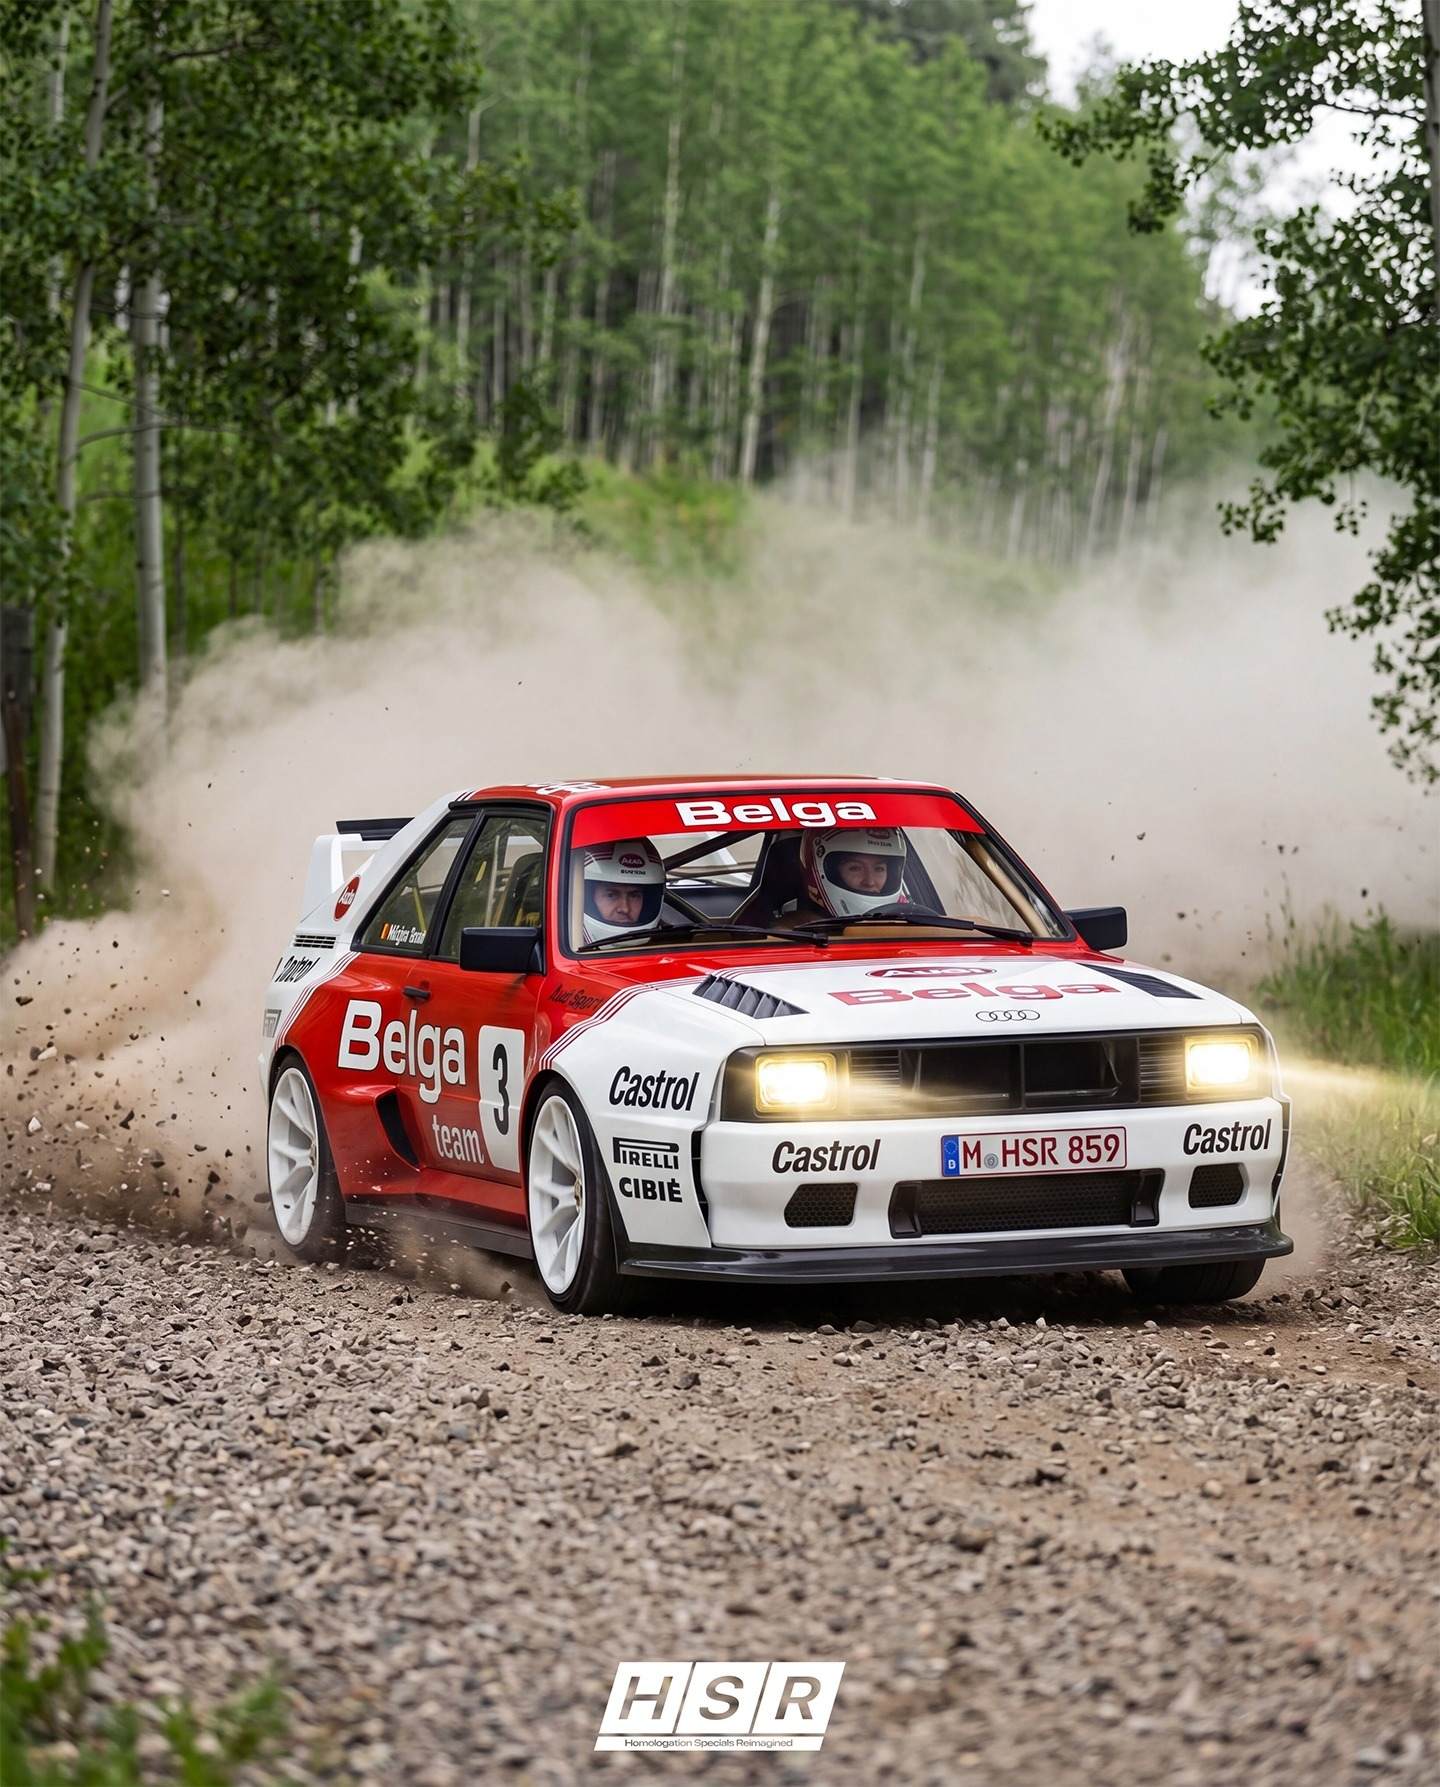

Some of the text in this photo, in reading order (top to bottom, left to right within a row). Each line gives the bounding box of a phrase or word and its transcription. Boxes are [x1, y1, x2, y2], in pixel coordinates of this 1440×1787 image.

[675, 797, 877, 827] Belga
[828, 982, 1121, 1006] Belga
[337, 999, 466, 1104] Belga
[492, 1043, 510, 1135] 3
[609, 1065, 700, 1111] Castrol
[431, 1114, 485, 1165] team
[612, 1136, 680, 1170] PIRELLI
[962, 1140, 982, 1169] M
[1002, 1137, 1059, 1168] HSR
[1068, 1133, 1120, 1165] 859
[1183, 1118, 1272, 1155] Castrol
[772, 1138, 881, 1174] Castrol
